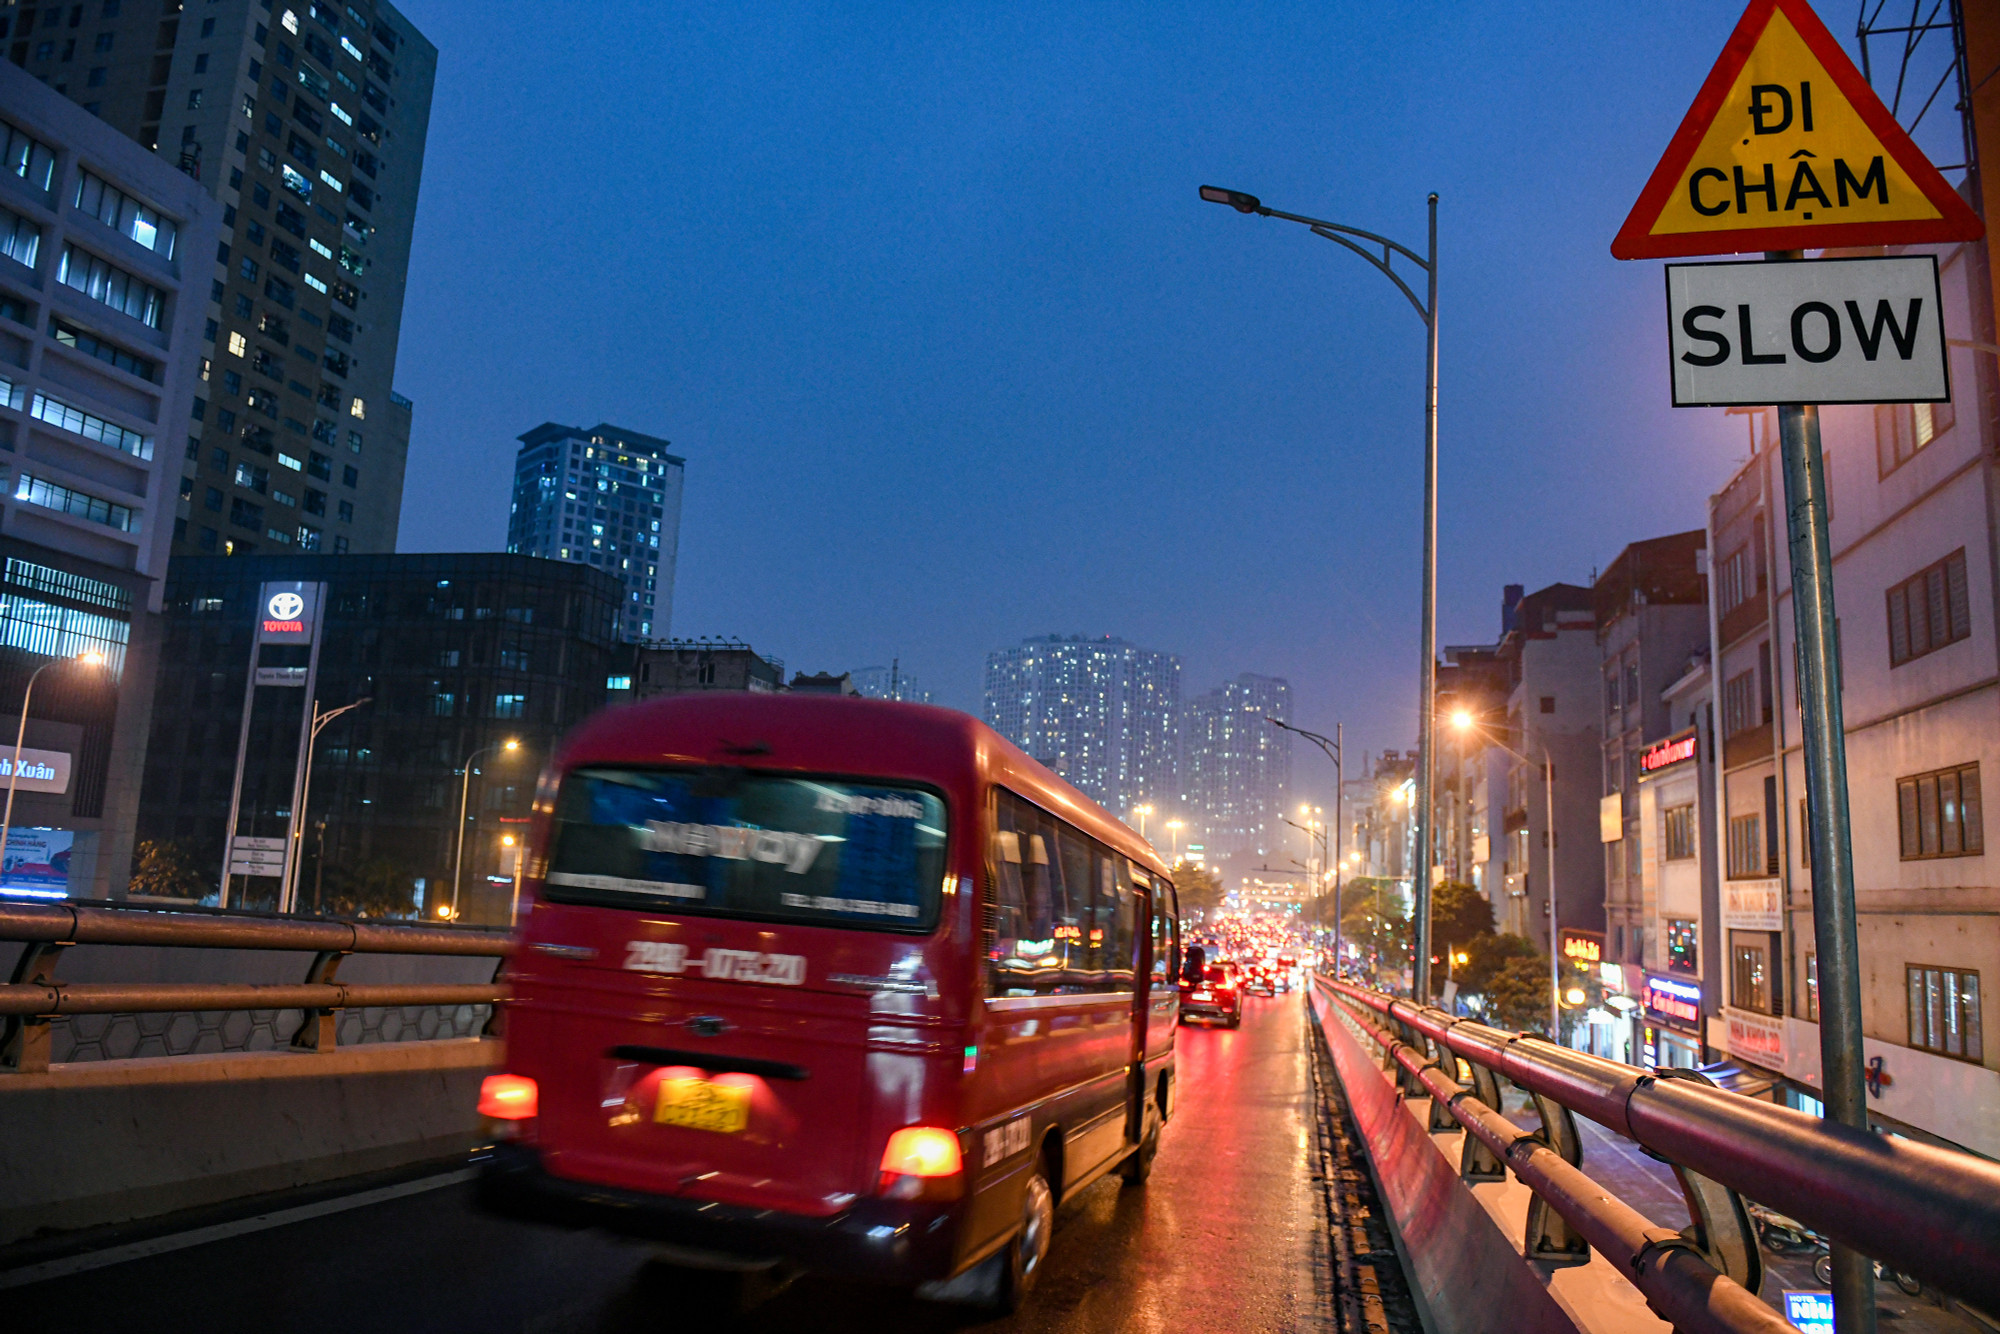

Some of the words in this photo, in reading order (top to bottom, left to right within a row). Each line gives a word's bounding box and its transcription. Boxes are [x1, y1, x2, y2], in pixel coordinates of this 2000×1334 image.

[1748, 81, 1814, 135] ĐI
[1688, 149, 1890, 220] CHẬM
[1681, 298, 1923, 367] SLOW
[263, 621, 303, 632] TOYOTA
[15, 760, 55, 780] Xuân
[1789, 1295, 1817, 1303] HOTEL
